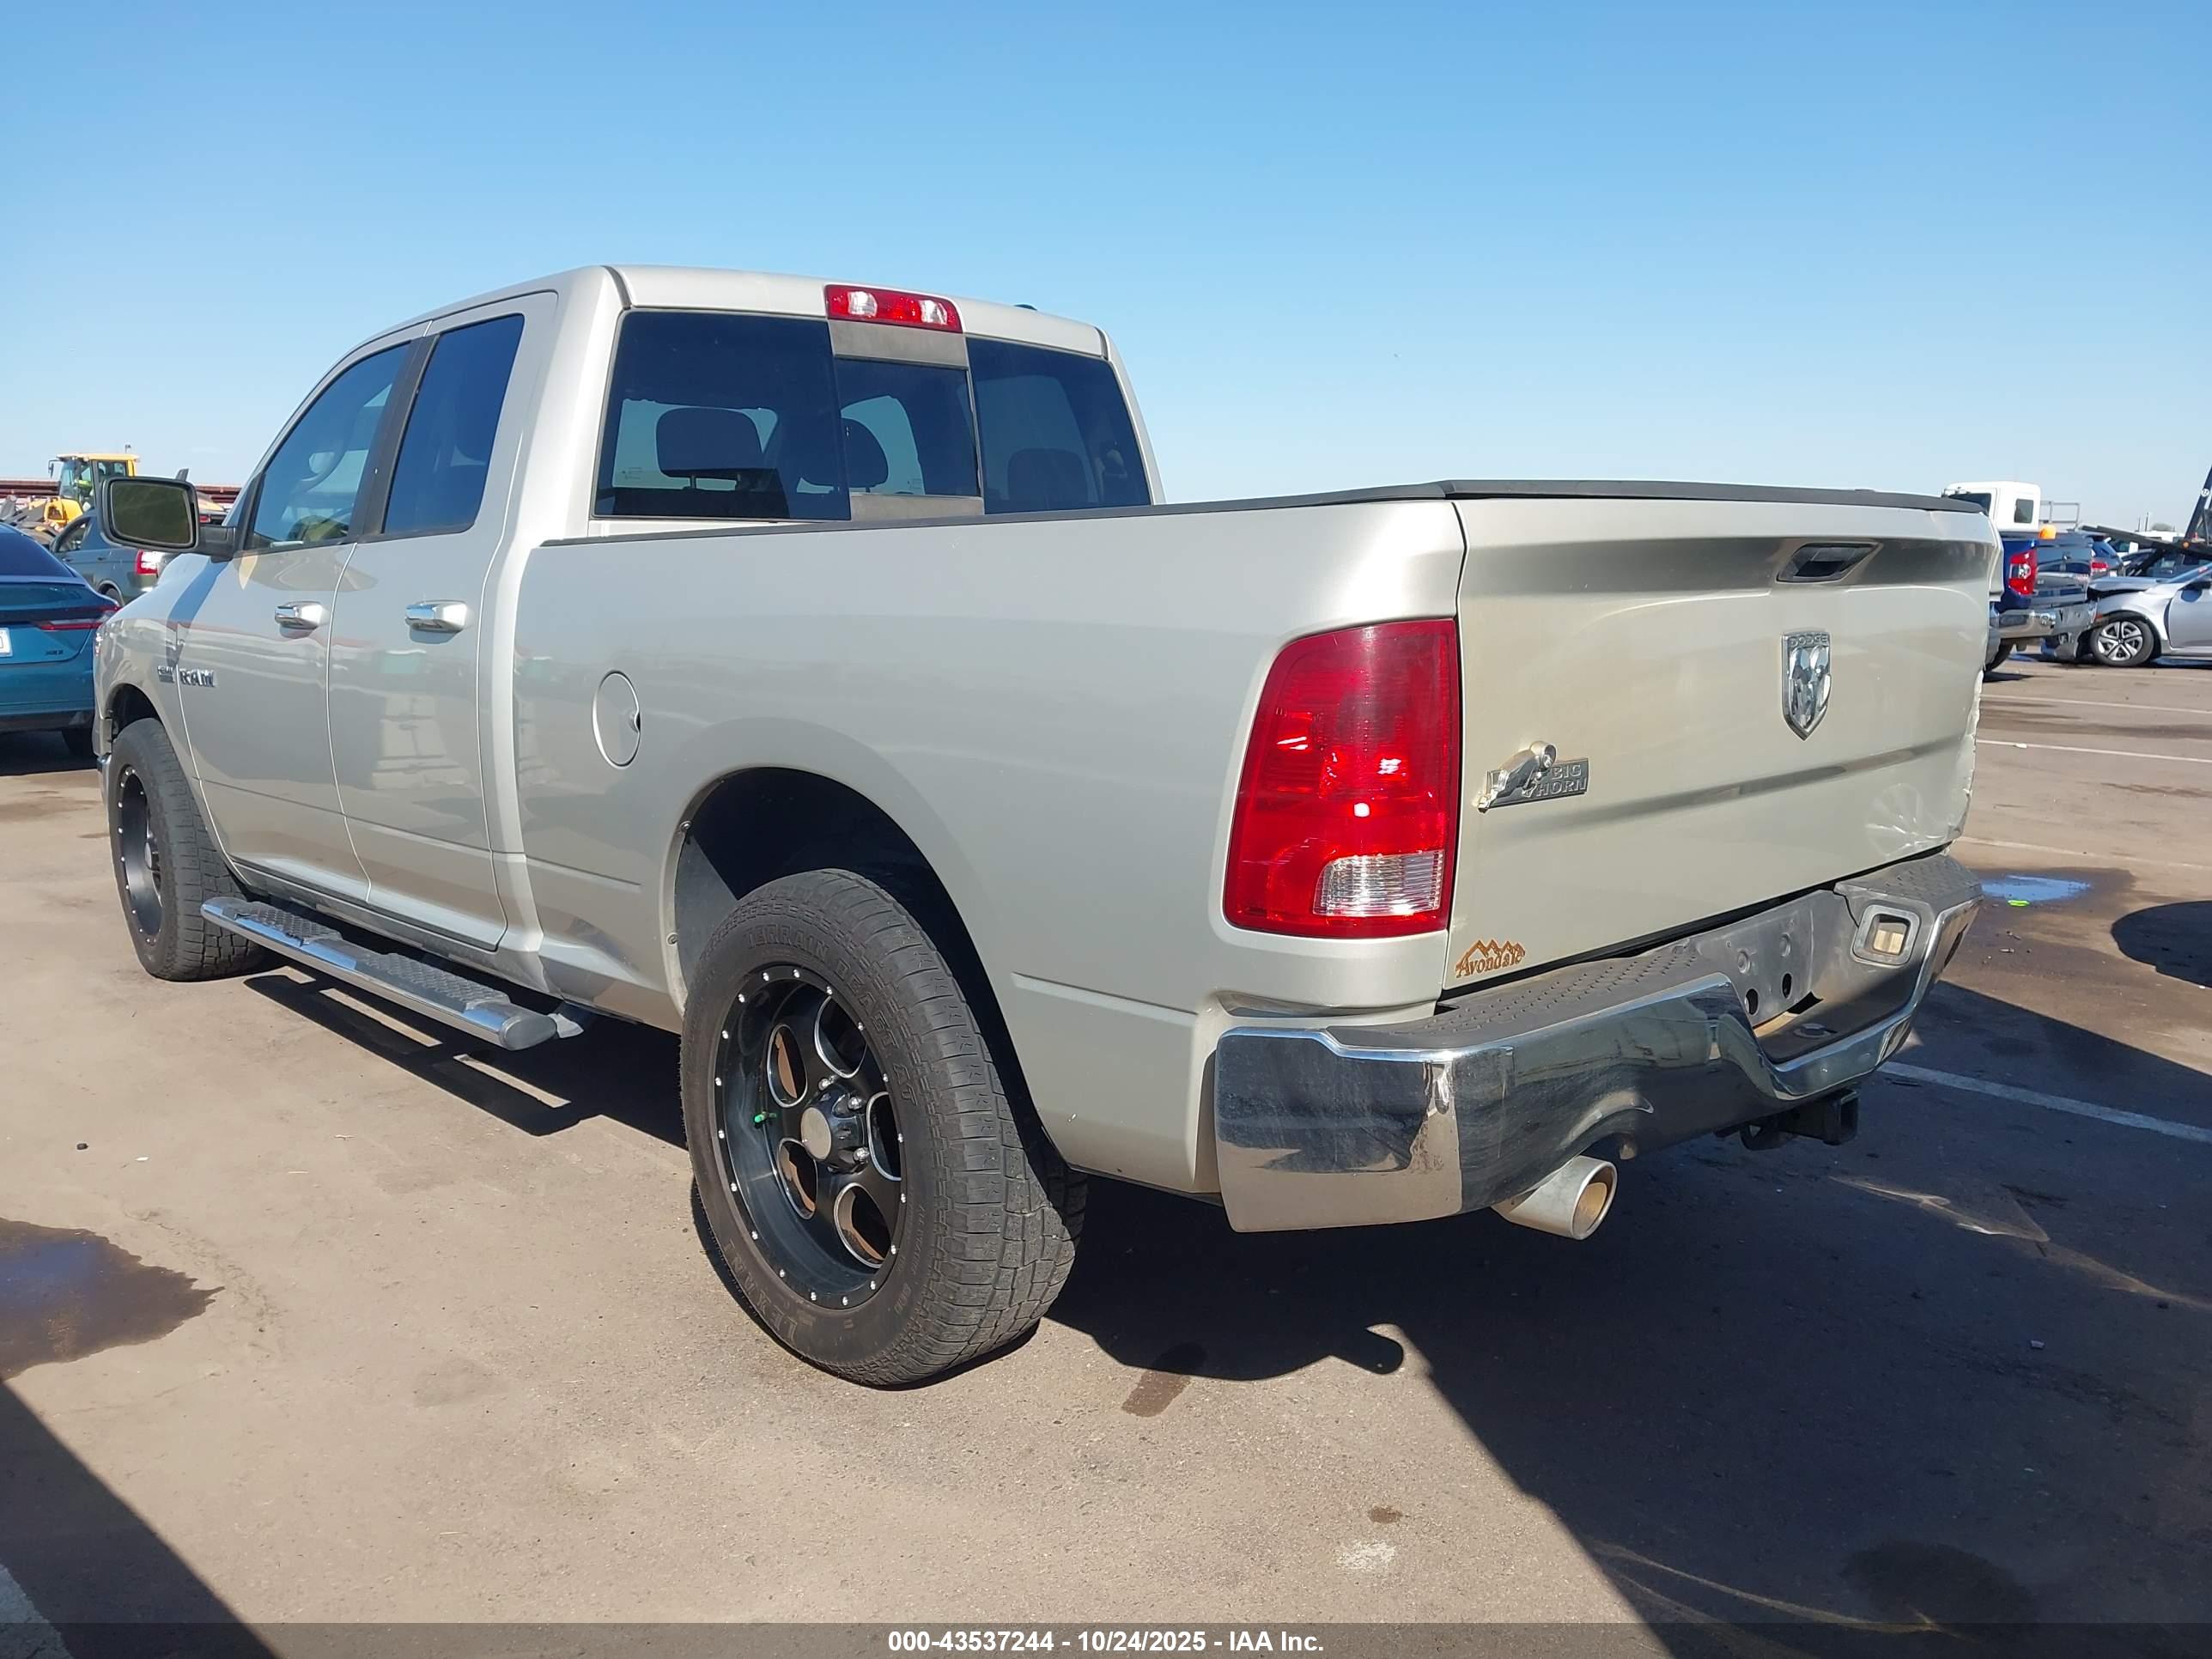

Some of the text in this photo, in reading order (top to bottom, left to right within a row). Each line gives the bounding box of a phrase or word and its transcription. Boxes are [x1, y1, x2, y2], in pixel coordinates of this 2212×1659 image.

[1790, 634, 1829, 647] DODGE
[179, 667, 216, 688] RAM
[1552, 764, 1582, 781] BIG
[1535, 777, 1588, 797] HORN
[745, 923, 830, 963] TERRAIN
[1455, 946, 1524, 979] Avondale
